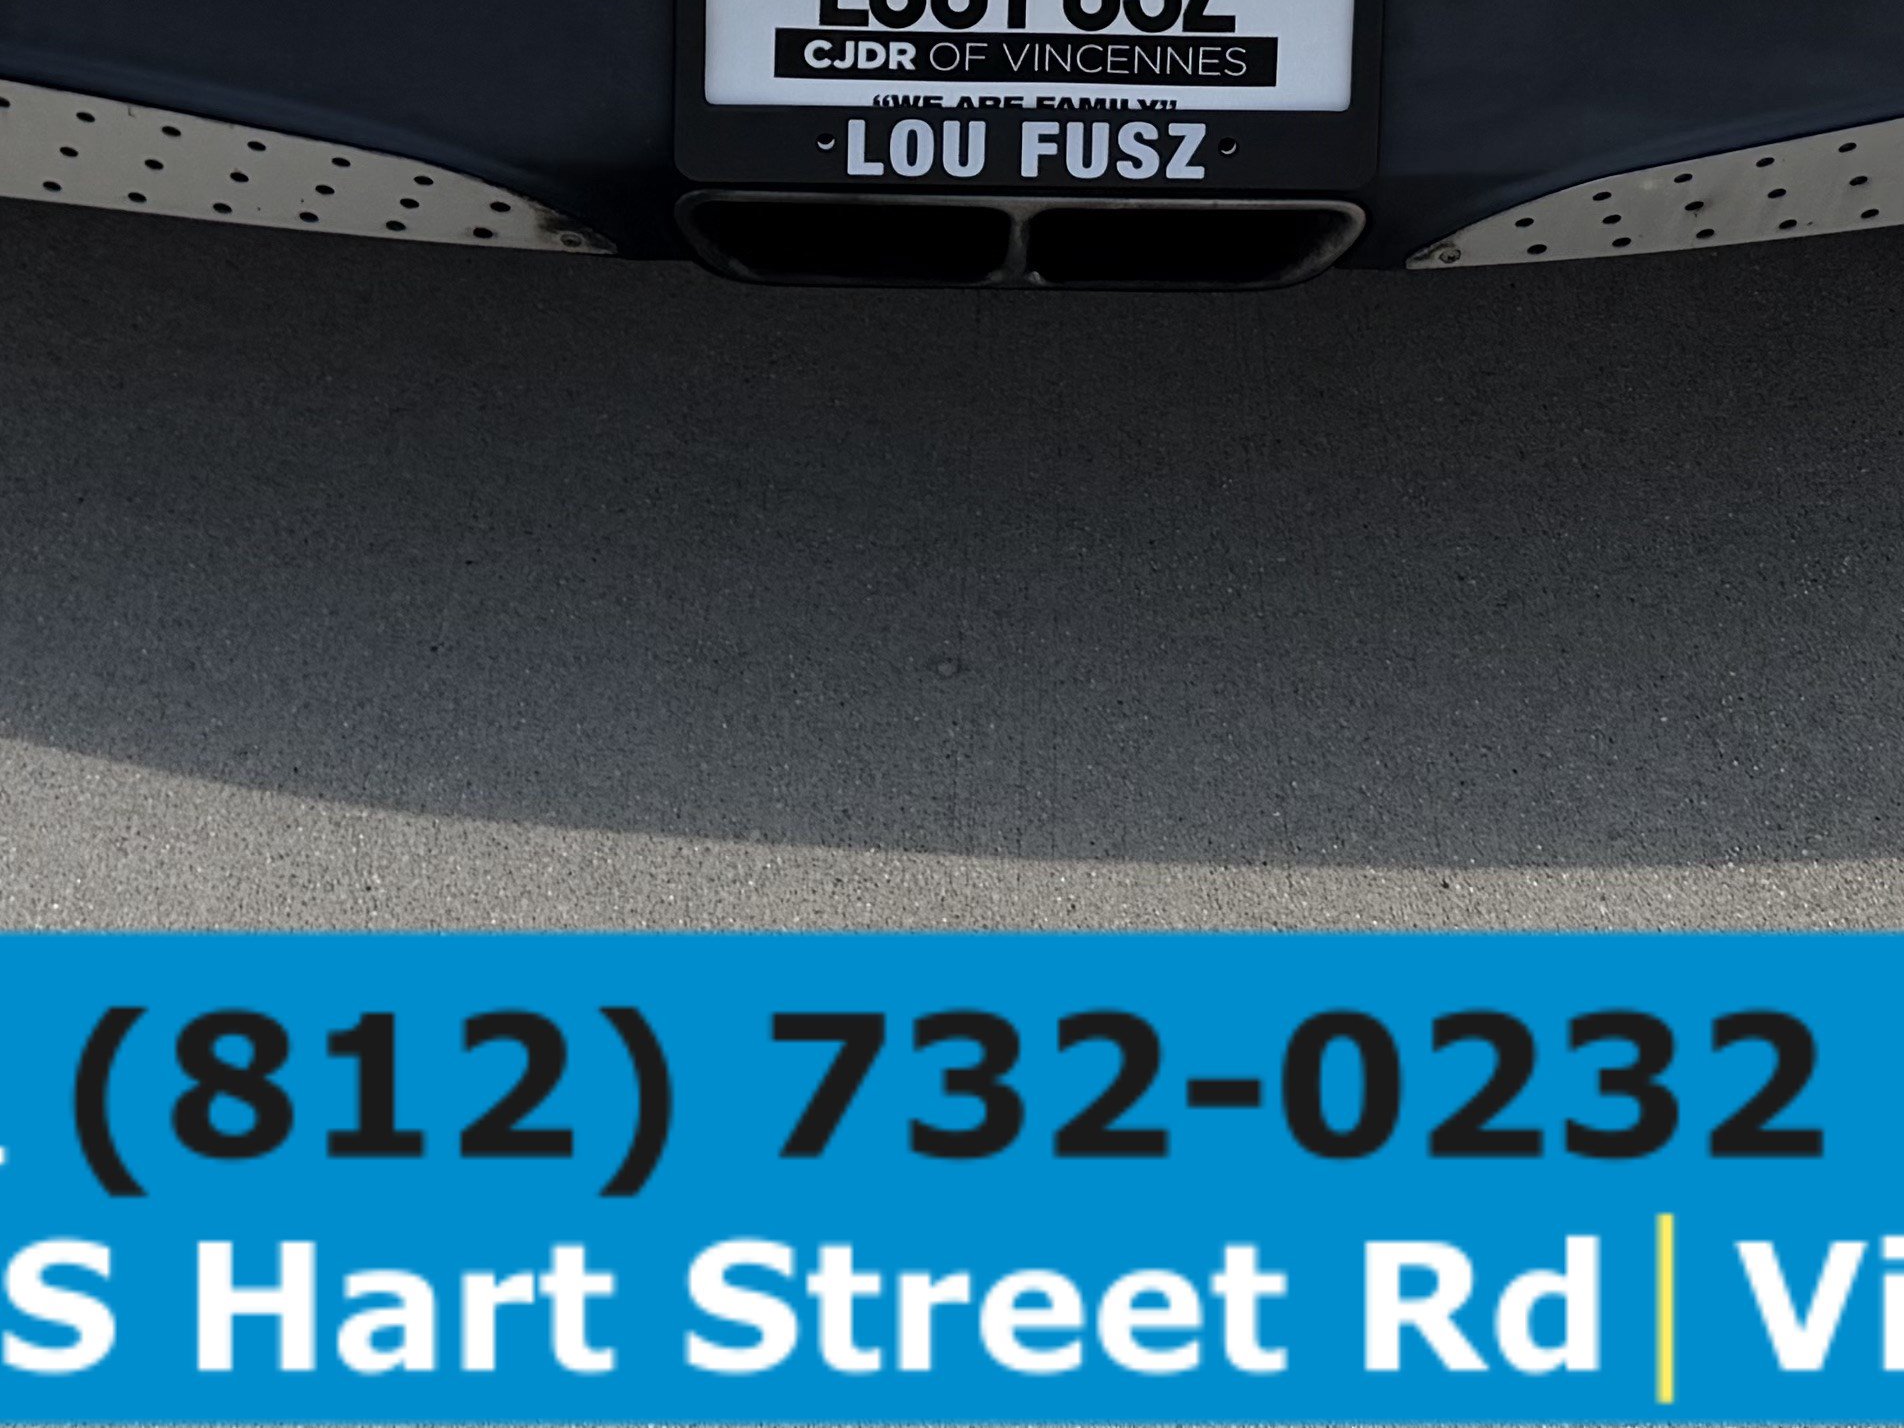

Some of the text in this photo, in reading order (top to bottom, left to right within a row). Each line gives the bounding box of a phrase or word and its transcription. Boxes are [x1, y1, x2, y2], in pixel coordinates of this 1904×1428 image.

[803, 39, 1248, 77] CJDR OF VINCENNES
[847, 119, 1206, 180] LOU FUSZ
